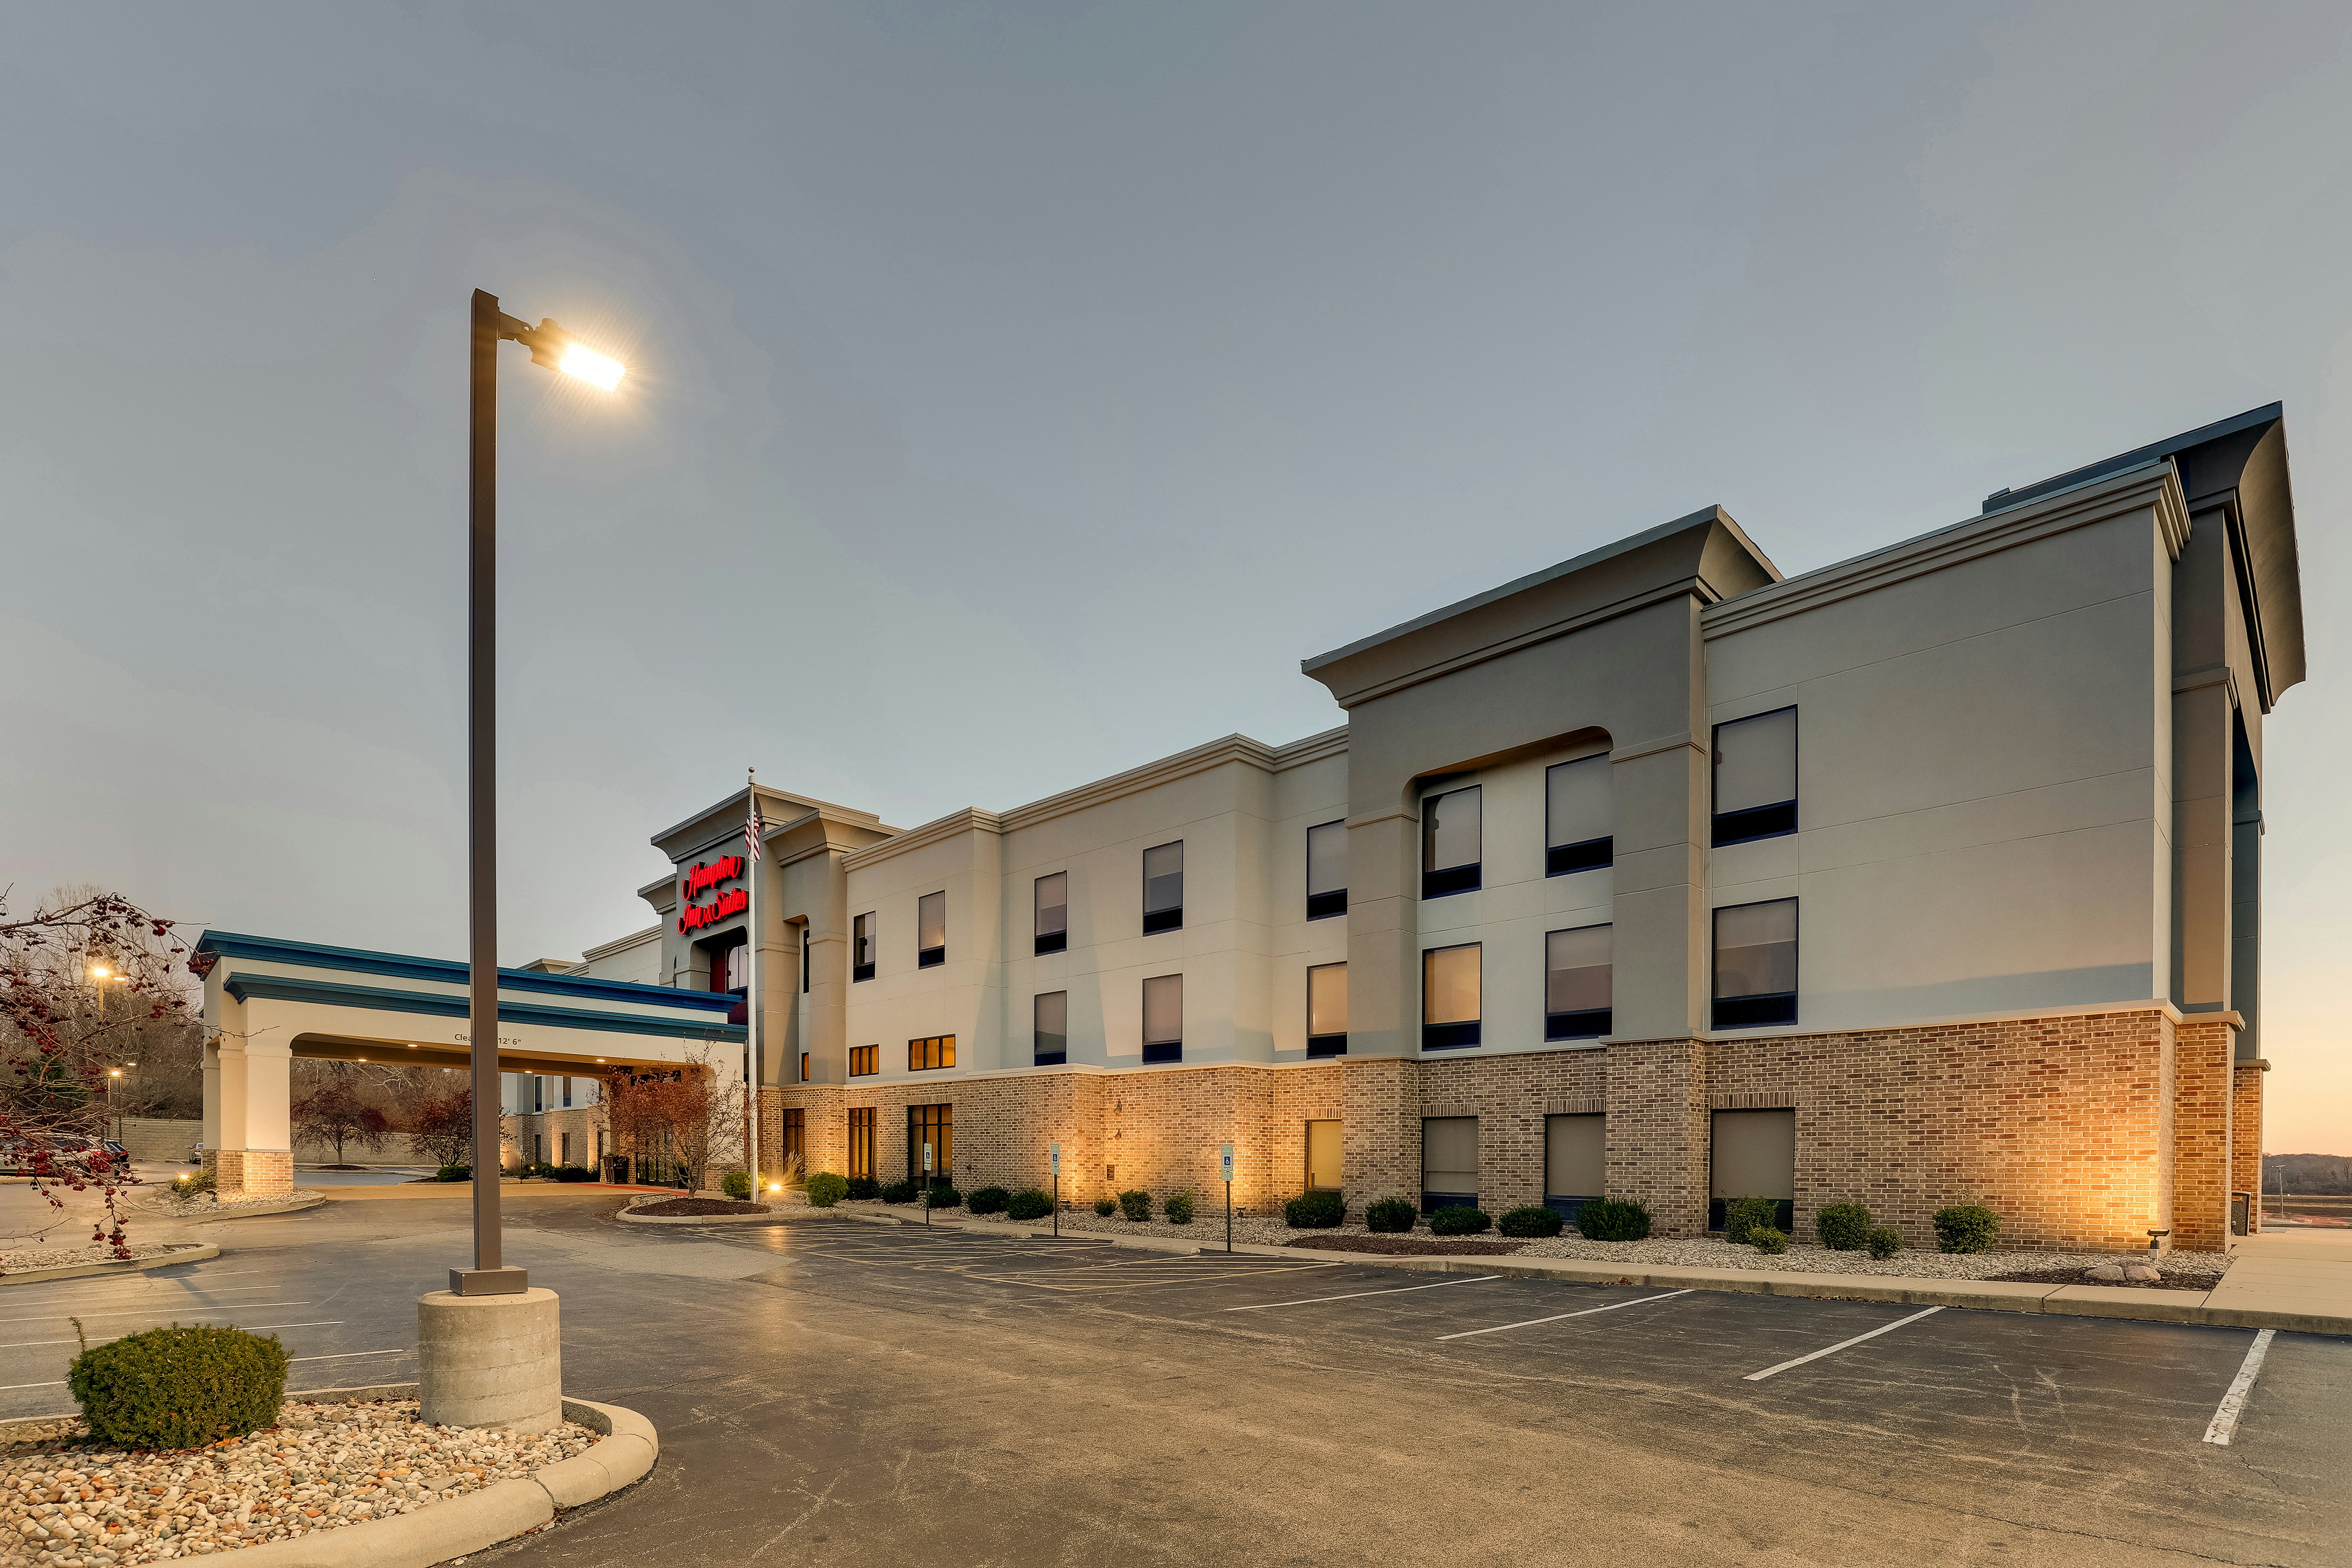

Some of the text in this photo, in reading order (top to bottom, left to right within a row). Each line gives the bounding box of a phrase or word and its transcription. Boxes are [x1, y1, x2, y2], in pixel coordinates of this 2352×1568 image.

[682, 855, 741, 901] Hampton
[678, 904, 706, 935] Inn
[712, 887, 747, 920] Suites
